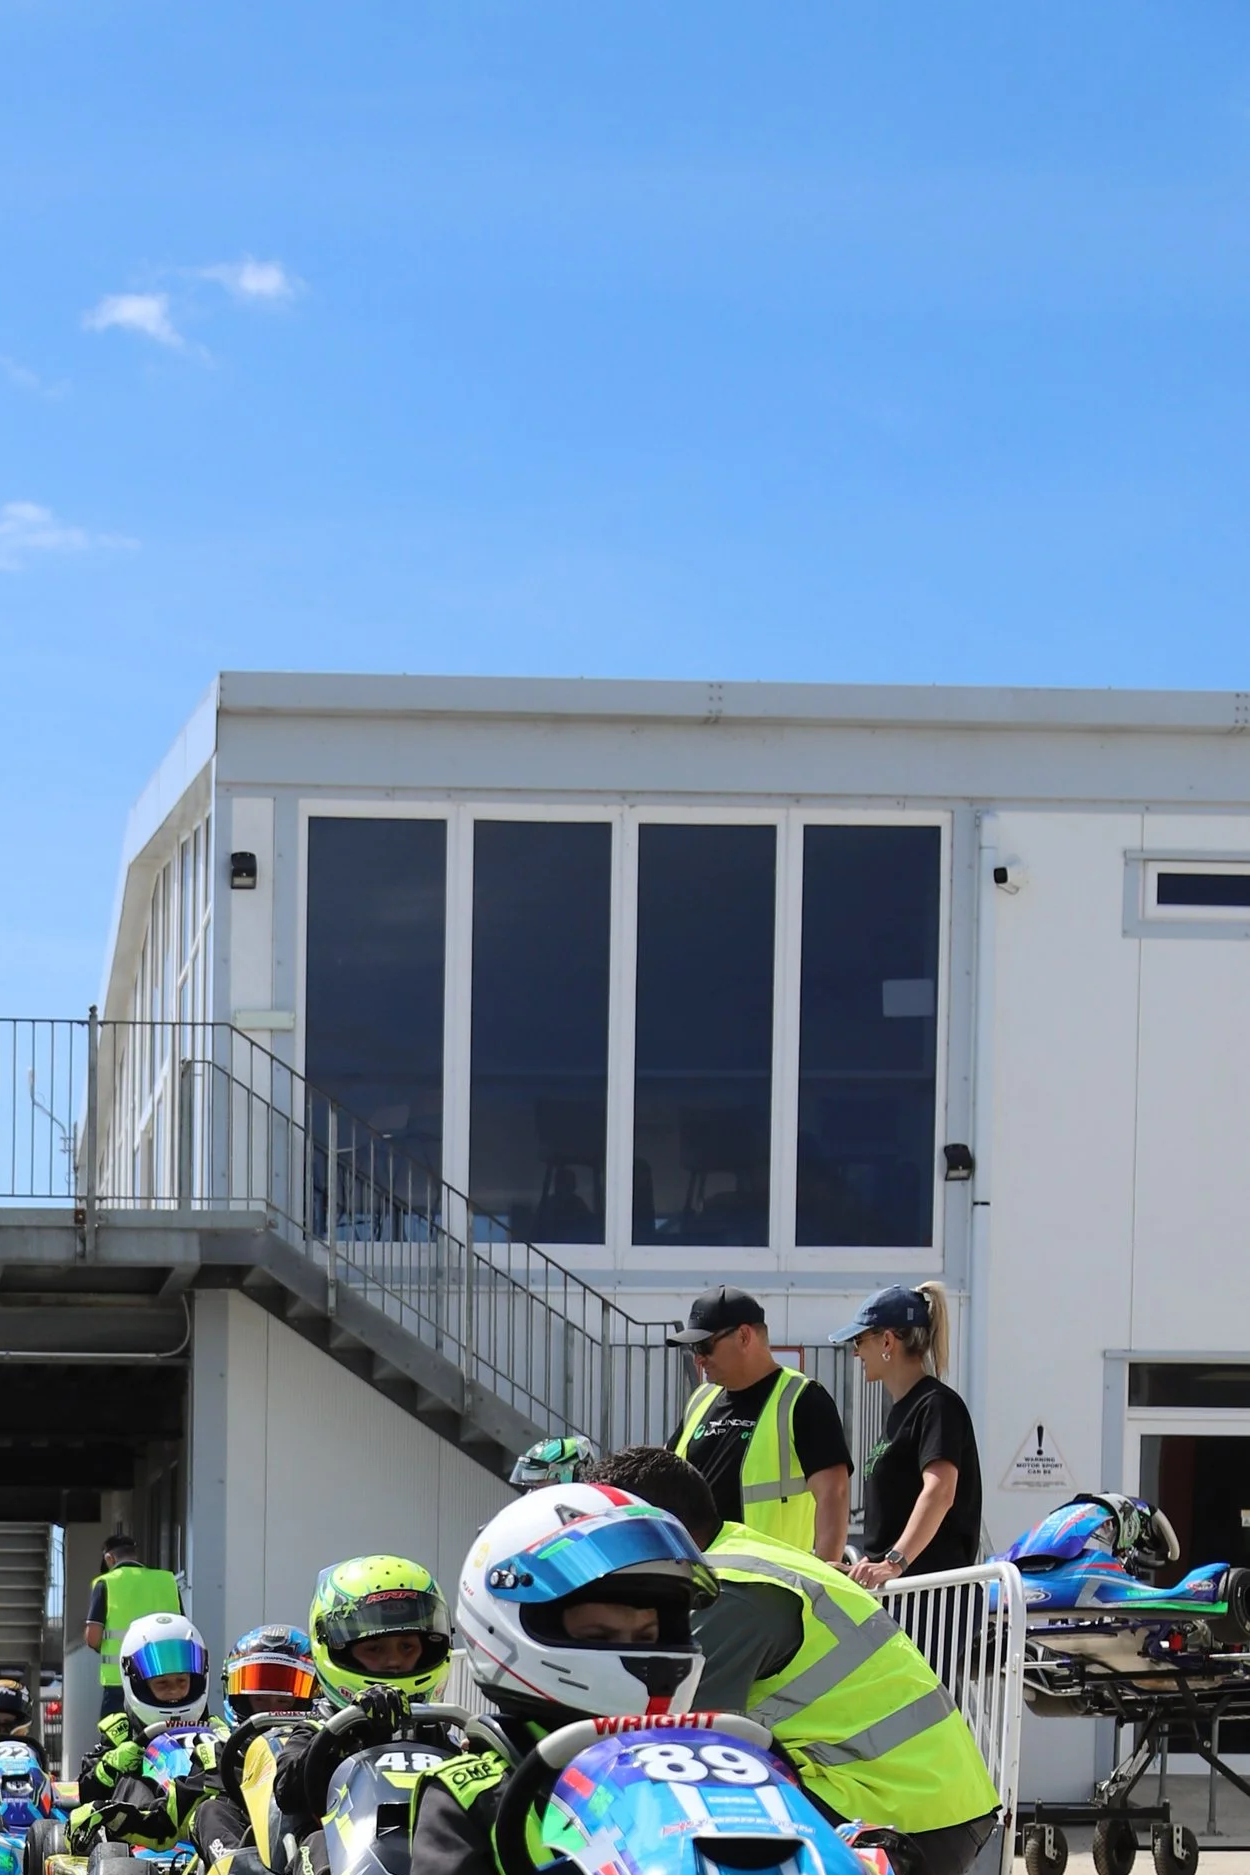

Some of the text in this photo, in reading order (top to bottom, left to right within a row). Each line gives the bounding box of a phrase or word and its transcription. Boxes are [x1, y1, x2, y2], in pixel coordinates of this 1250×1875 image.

[593, 1711, 719, 1736] WRIGHT
[375, 1752, 444, 1772] 48
[452, 1761, 492, 1786] OMP
[637, 1743, 770, 1785] 89
